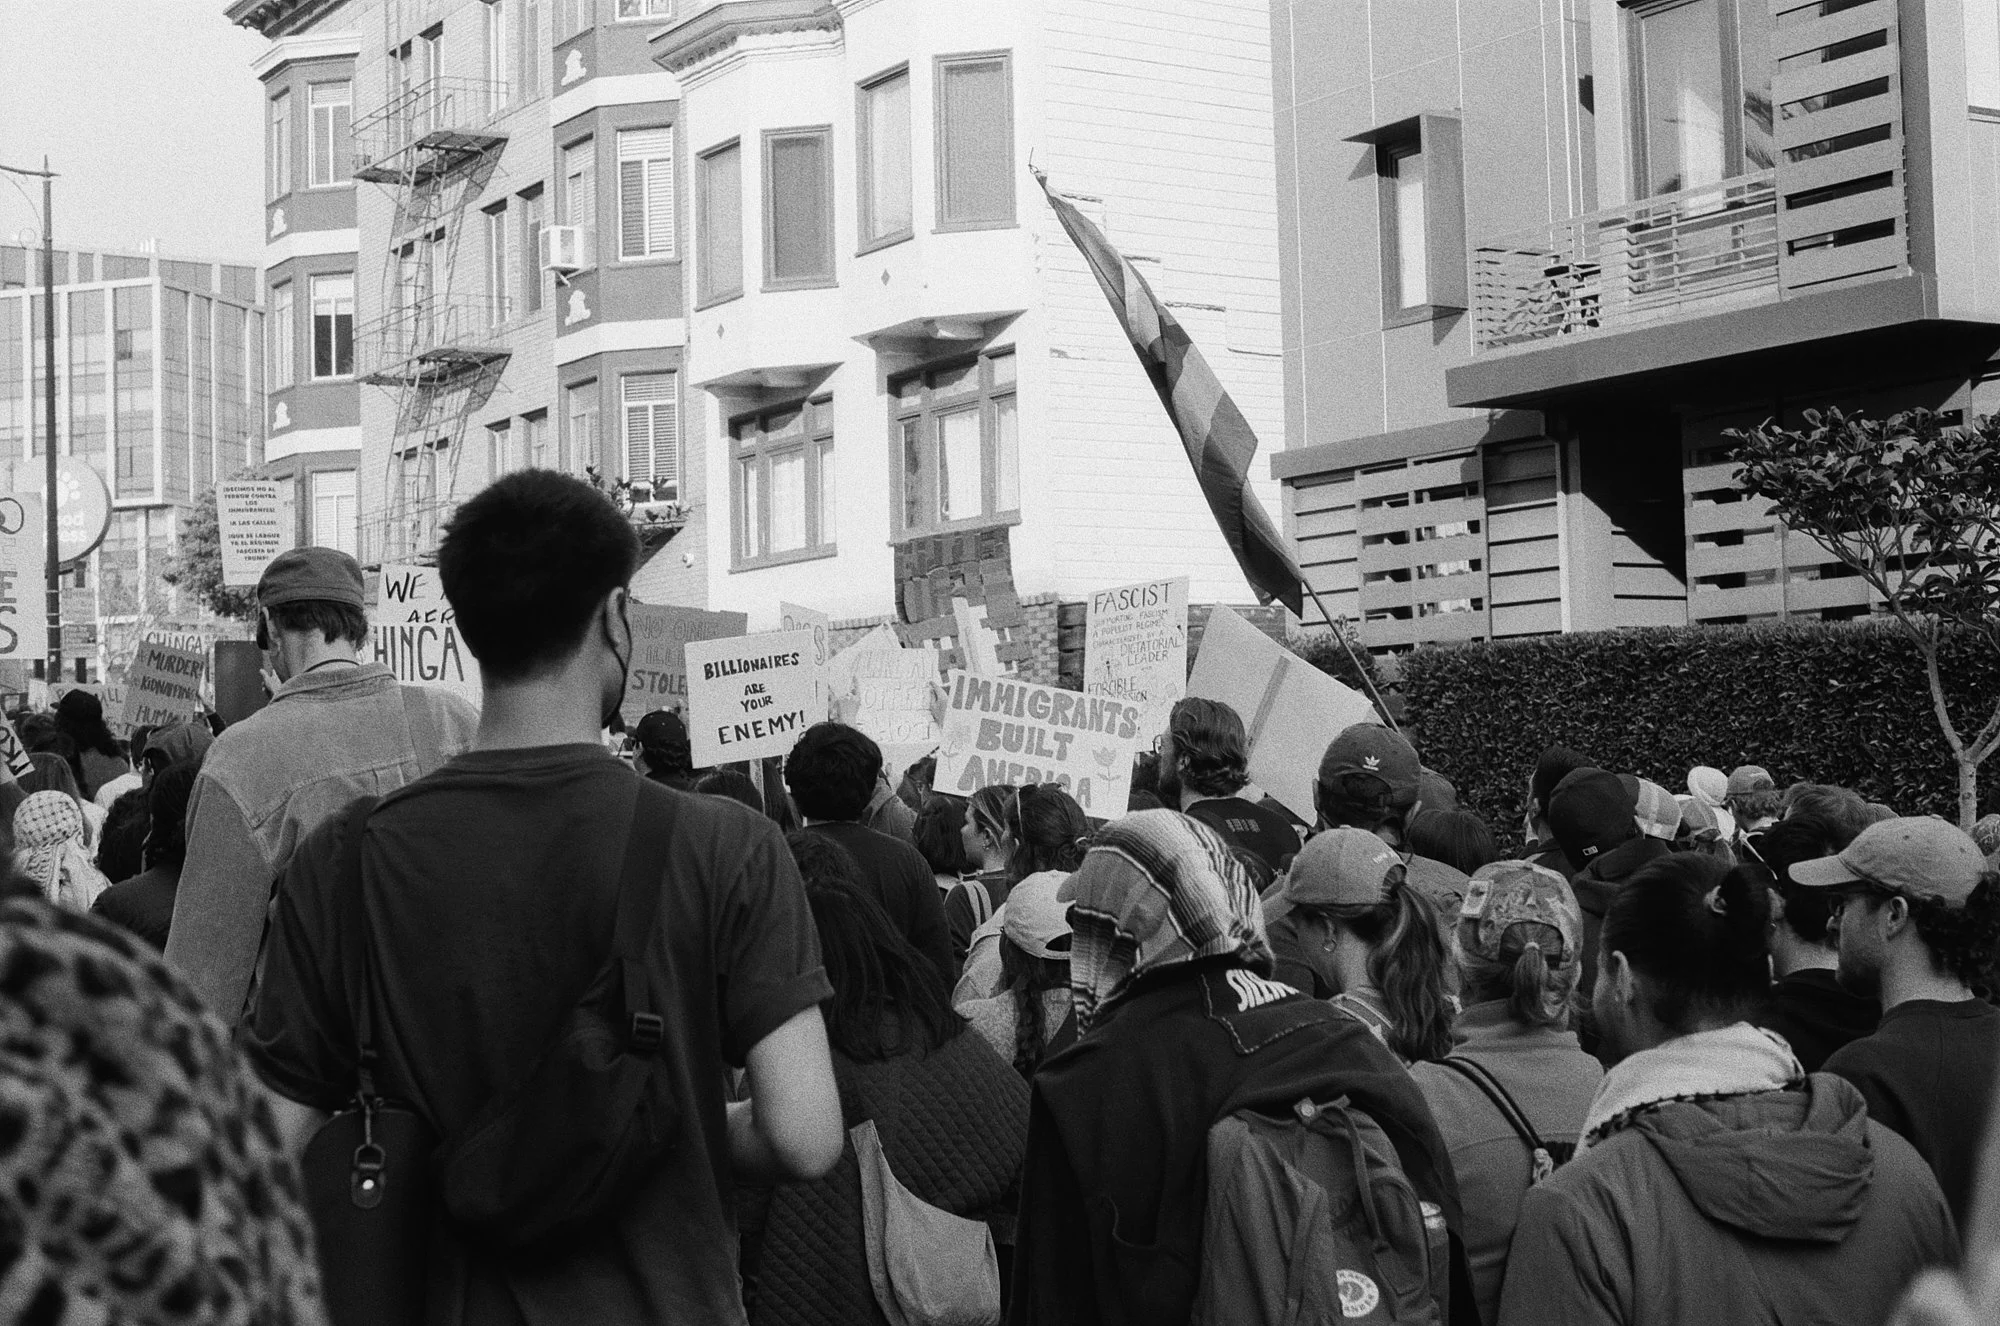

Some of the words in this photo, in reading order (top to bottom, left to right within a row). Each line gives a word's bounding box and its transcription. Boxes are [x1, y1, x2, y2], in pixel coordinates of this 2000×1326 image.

[385, 572, 427, 603] WE
[1094, 582, 1174, 614] FASCIST
[373, 625, 465, 681] HINGA
[1120, 636, 1185, 657] DICTATORIAL
[1127, 650, 1169, 667] LEADER
[703, 652, 800, 681] BILLIONAIRES
[631, 668, 688, 698] STOLE
[744, 683, 767, 696] ARE
[740, 695, 774, 713] YOUR
[951, 675, 1138, 739] IMMIGRANTS
[718, 710, 806, 745] ENEMY!
[975, 717, 1075, 761] BUILT
